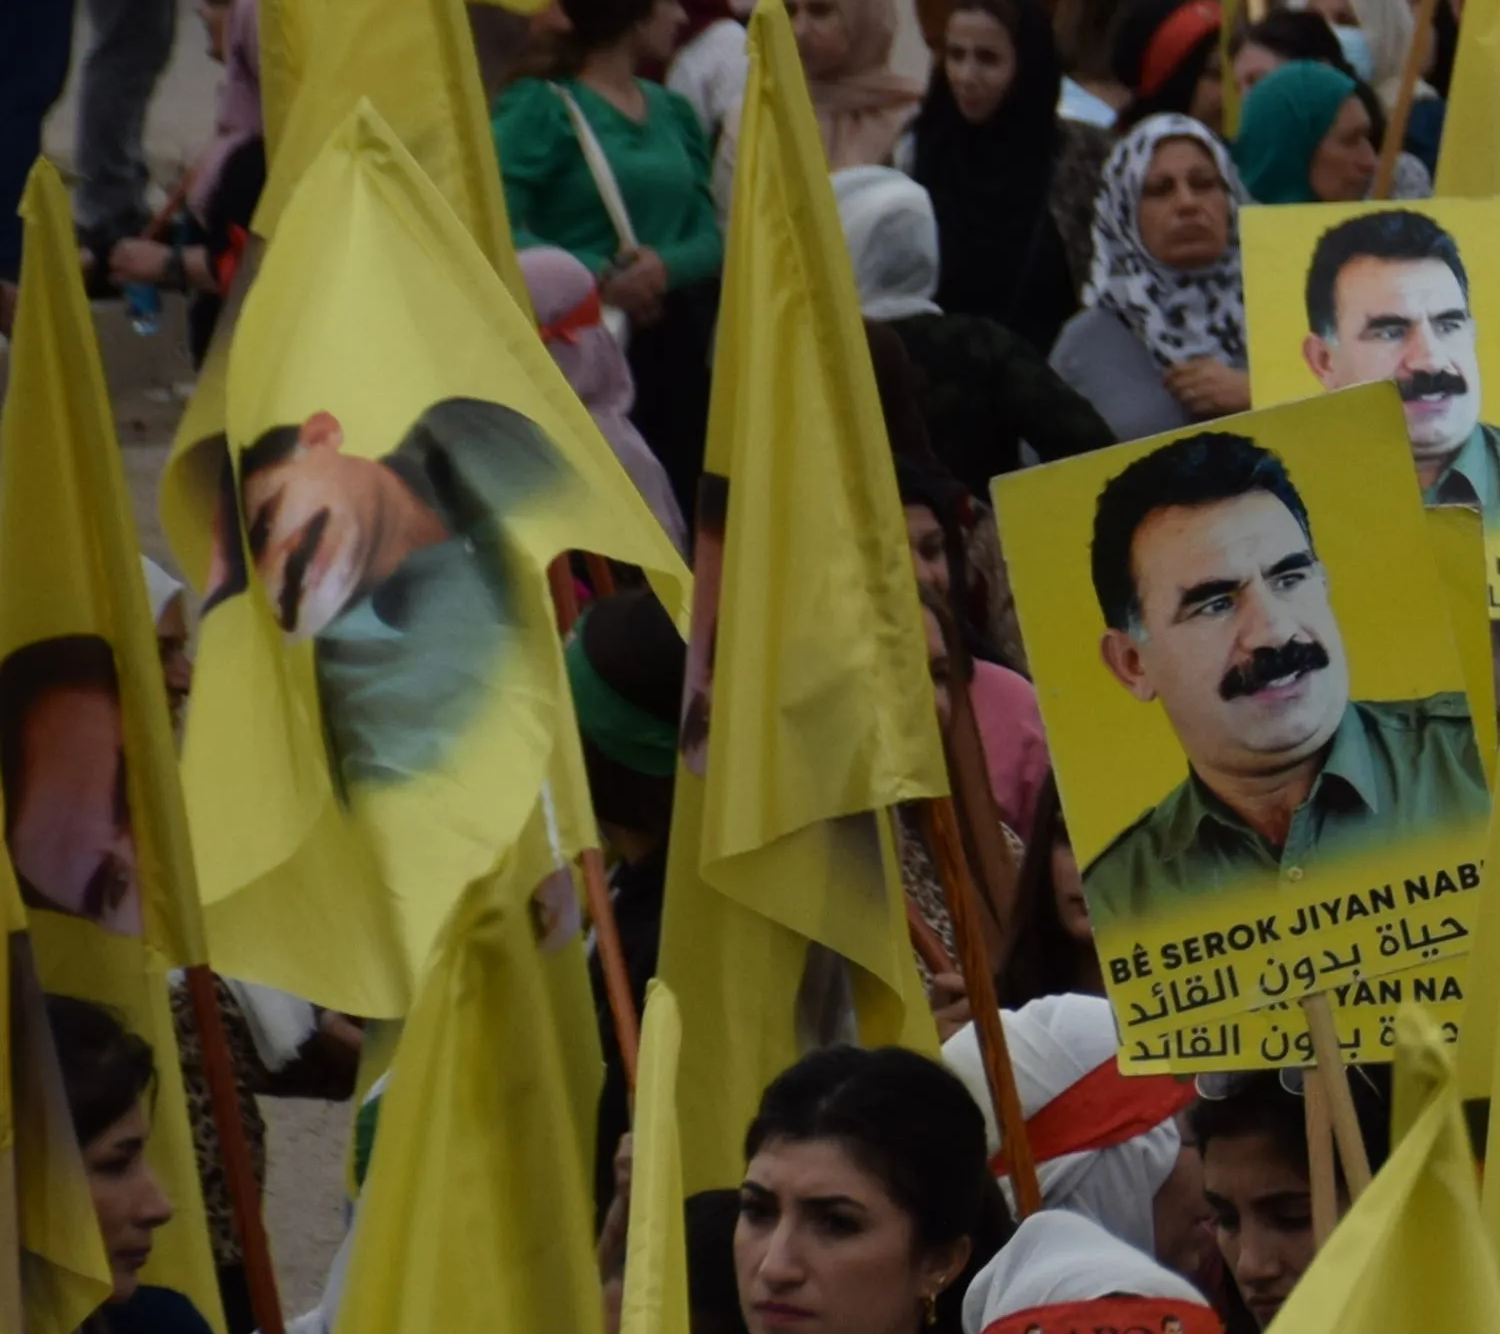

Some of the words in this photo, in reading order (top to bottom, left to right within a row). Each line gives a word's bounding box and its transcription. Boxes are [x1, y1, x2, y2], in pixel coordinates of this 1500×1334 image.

[1109, 942, 1153, 986] BÊ
[1160, 916, 1281, 971] SEROK
[1288, 884, 1396, 938] JIYAN
[1404, 859, 1486, 906] NAB
[1375, 914, 1469, 959] حياة
[1126, 964, 1240, 1027] القائد
[1258, 943, 1362, 996] بدون
